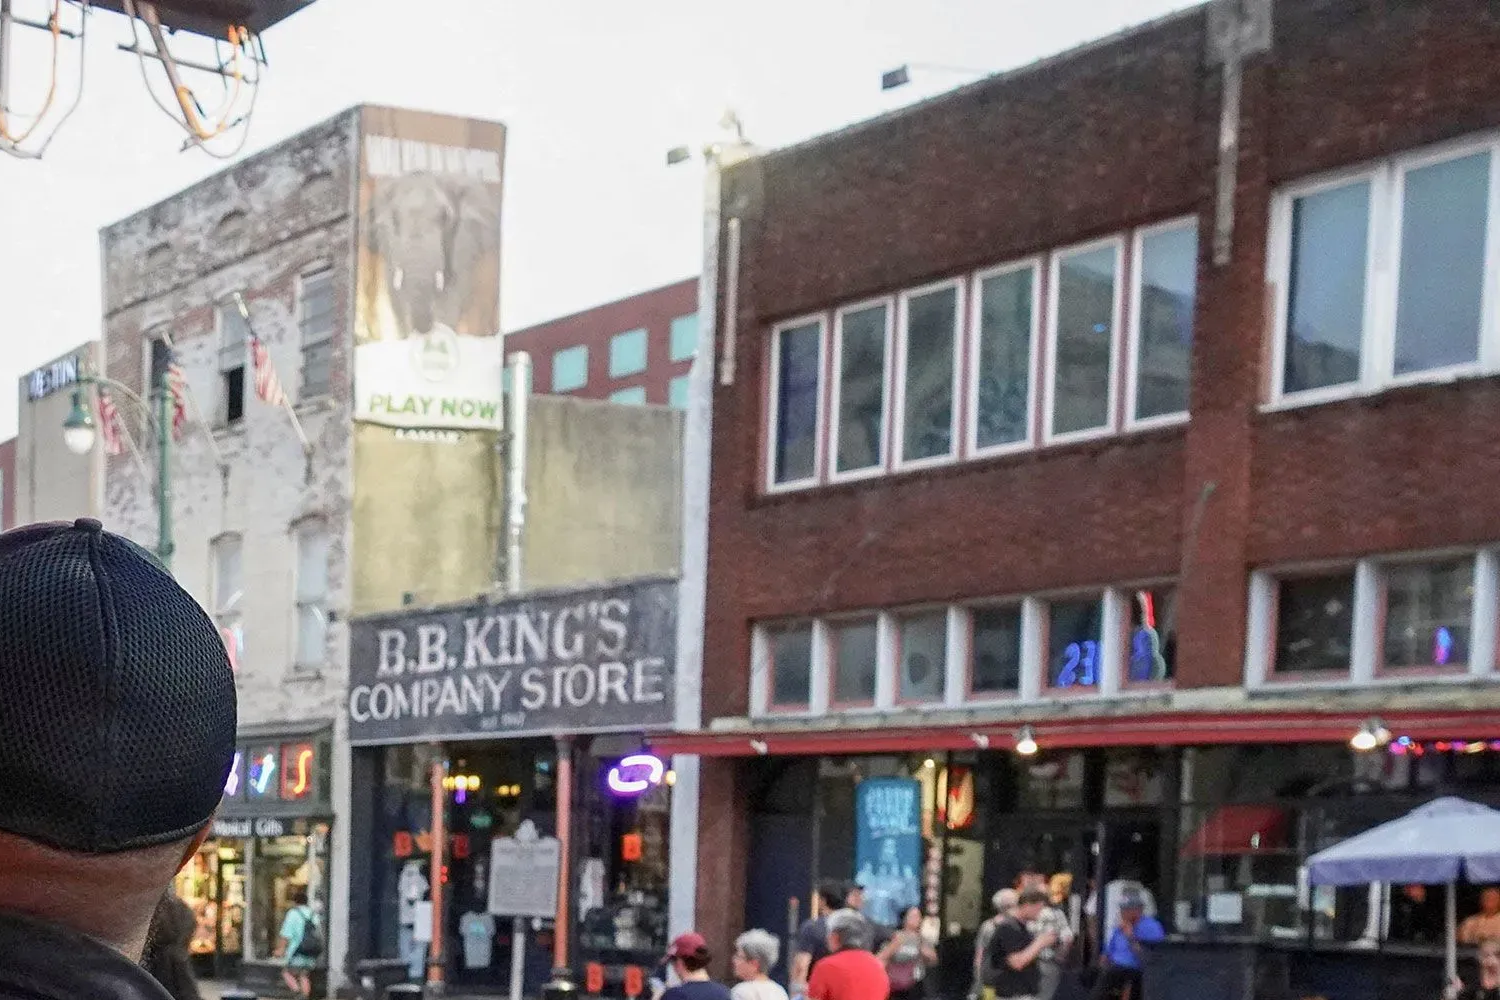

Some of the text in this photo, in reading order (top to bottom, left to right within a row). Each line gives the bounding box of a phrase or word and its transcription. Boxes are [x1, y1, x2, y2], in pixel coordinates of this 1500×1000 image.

[369, 392, 499, 421] PLAY NOW
[463, 598, 631, 669] KING'S
[350, 656, 666, 723] COMPANY STORE
